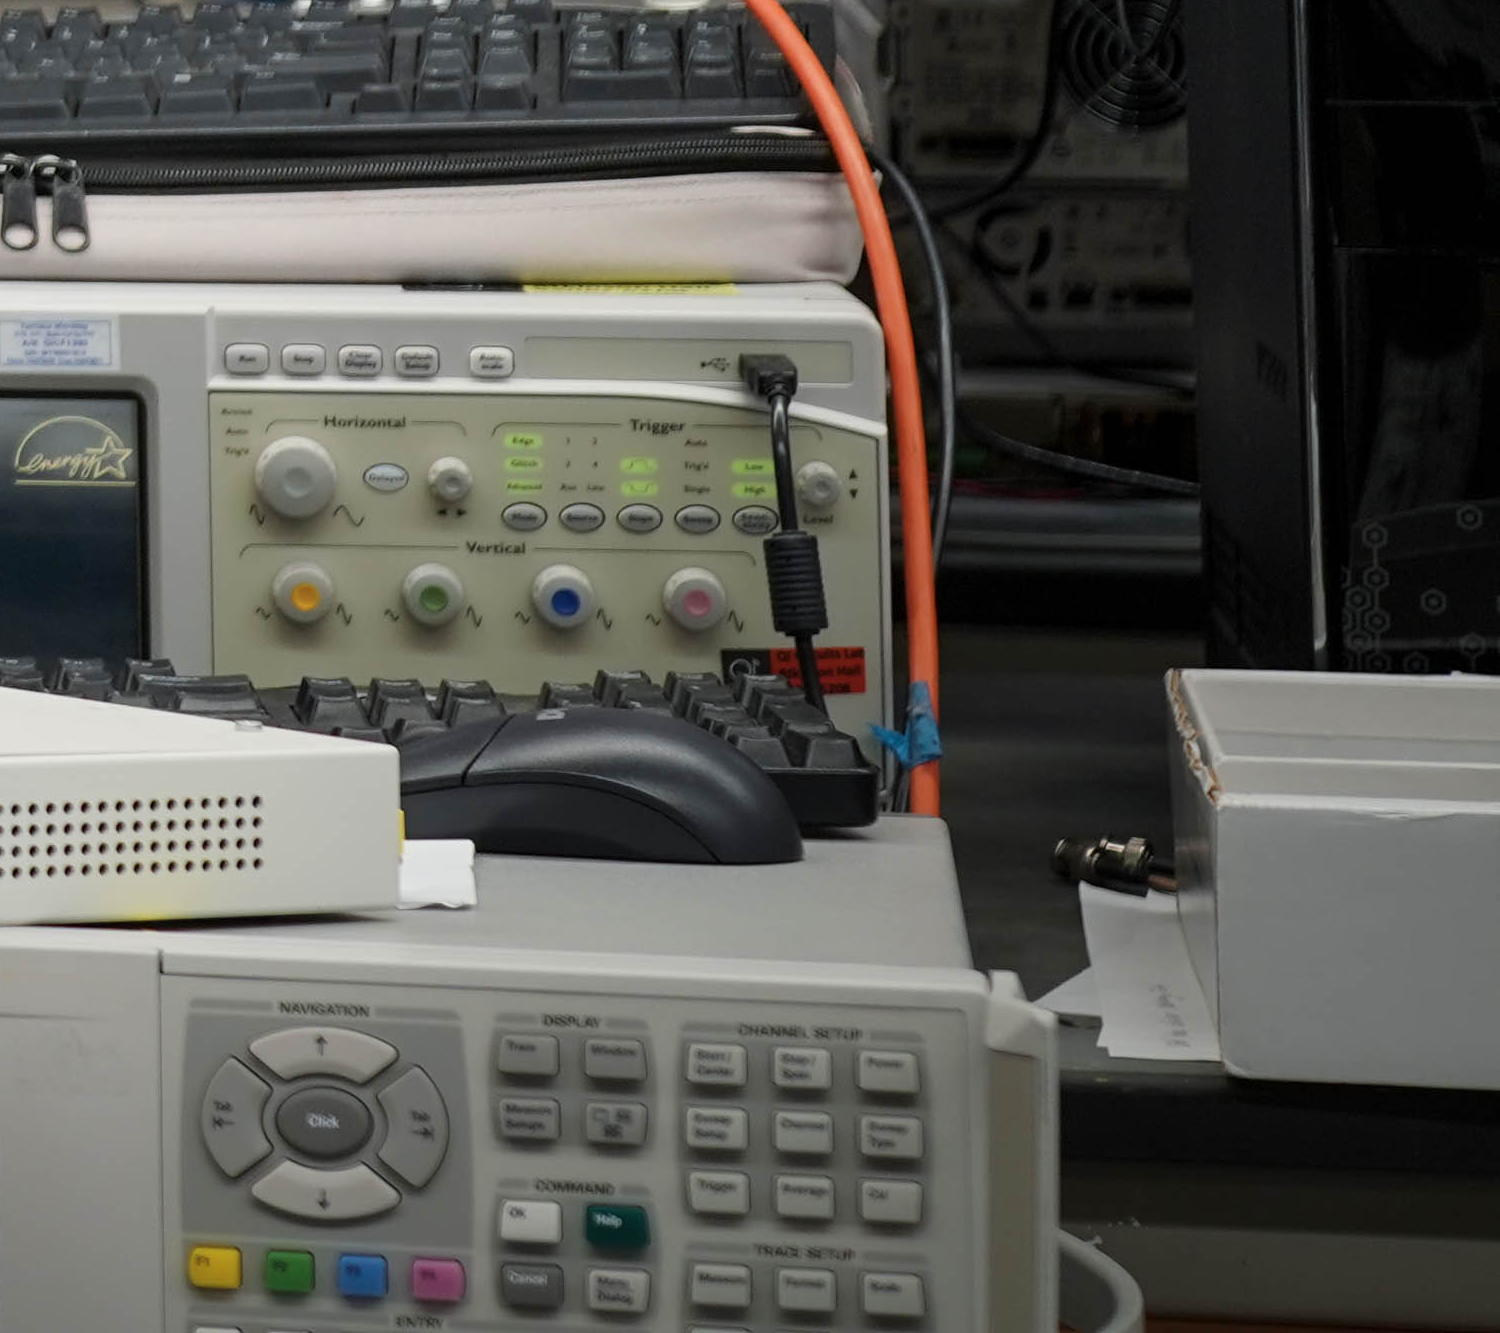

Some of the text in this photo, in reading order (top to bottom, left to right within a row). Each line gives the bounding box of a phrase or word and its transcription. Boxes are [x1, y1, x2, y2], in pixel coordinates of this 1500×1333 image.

[323, 414, 407, 429] Horizontal
[630, 419, 687, 435] Trigger
[511, 436, 535, 446] Edge
[683, 439, 708, 447] Auto
[26, 451, 98, 478] energy
[744, 462, 764, 471] Low
[683, 485, 711, 495] Single
[744, 486, 766, 496] High
[802, 514, 834, 524] Level
[465, 540, 526, 557] Vertical
[279, 1000, 371, 1018] NAVIGATION
[542, 1014, 602, 1030] DISPLAY
[737, 1023, 864, 1042] CHANNEL SETUP
[507, 1039, 537, 1053] Trace
[590, 1044, 637, 1057] Window
[865, 1057, 904, 1070] Power
[697, 1066, 736, 1078] Center
[306, 1112, 340, 1130] Click
[412, 1109, 431, 1123] Tab
[534, 1179, 616, 1196] COMMAND
[698, 1178, 738, 1193] Trigger
[866, 1188, 889, 1200] Cal
[508, 1206, 527, 1220] OK
[595, 1213, 623, 1229] Help
[753, 1243, 857, 1263] TRACE SETUP
[195, 1255, 211, 1267] F1
[271, 1260, 289, 1273] F2
[507, 1269, 549, 1287] Cancel
[396, 1316, 444, 1329] ENTRY
